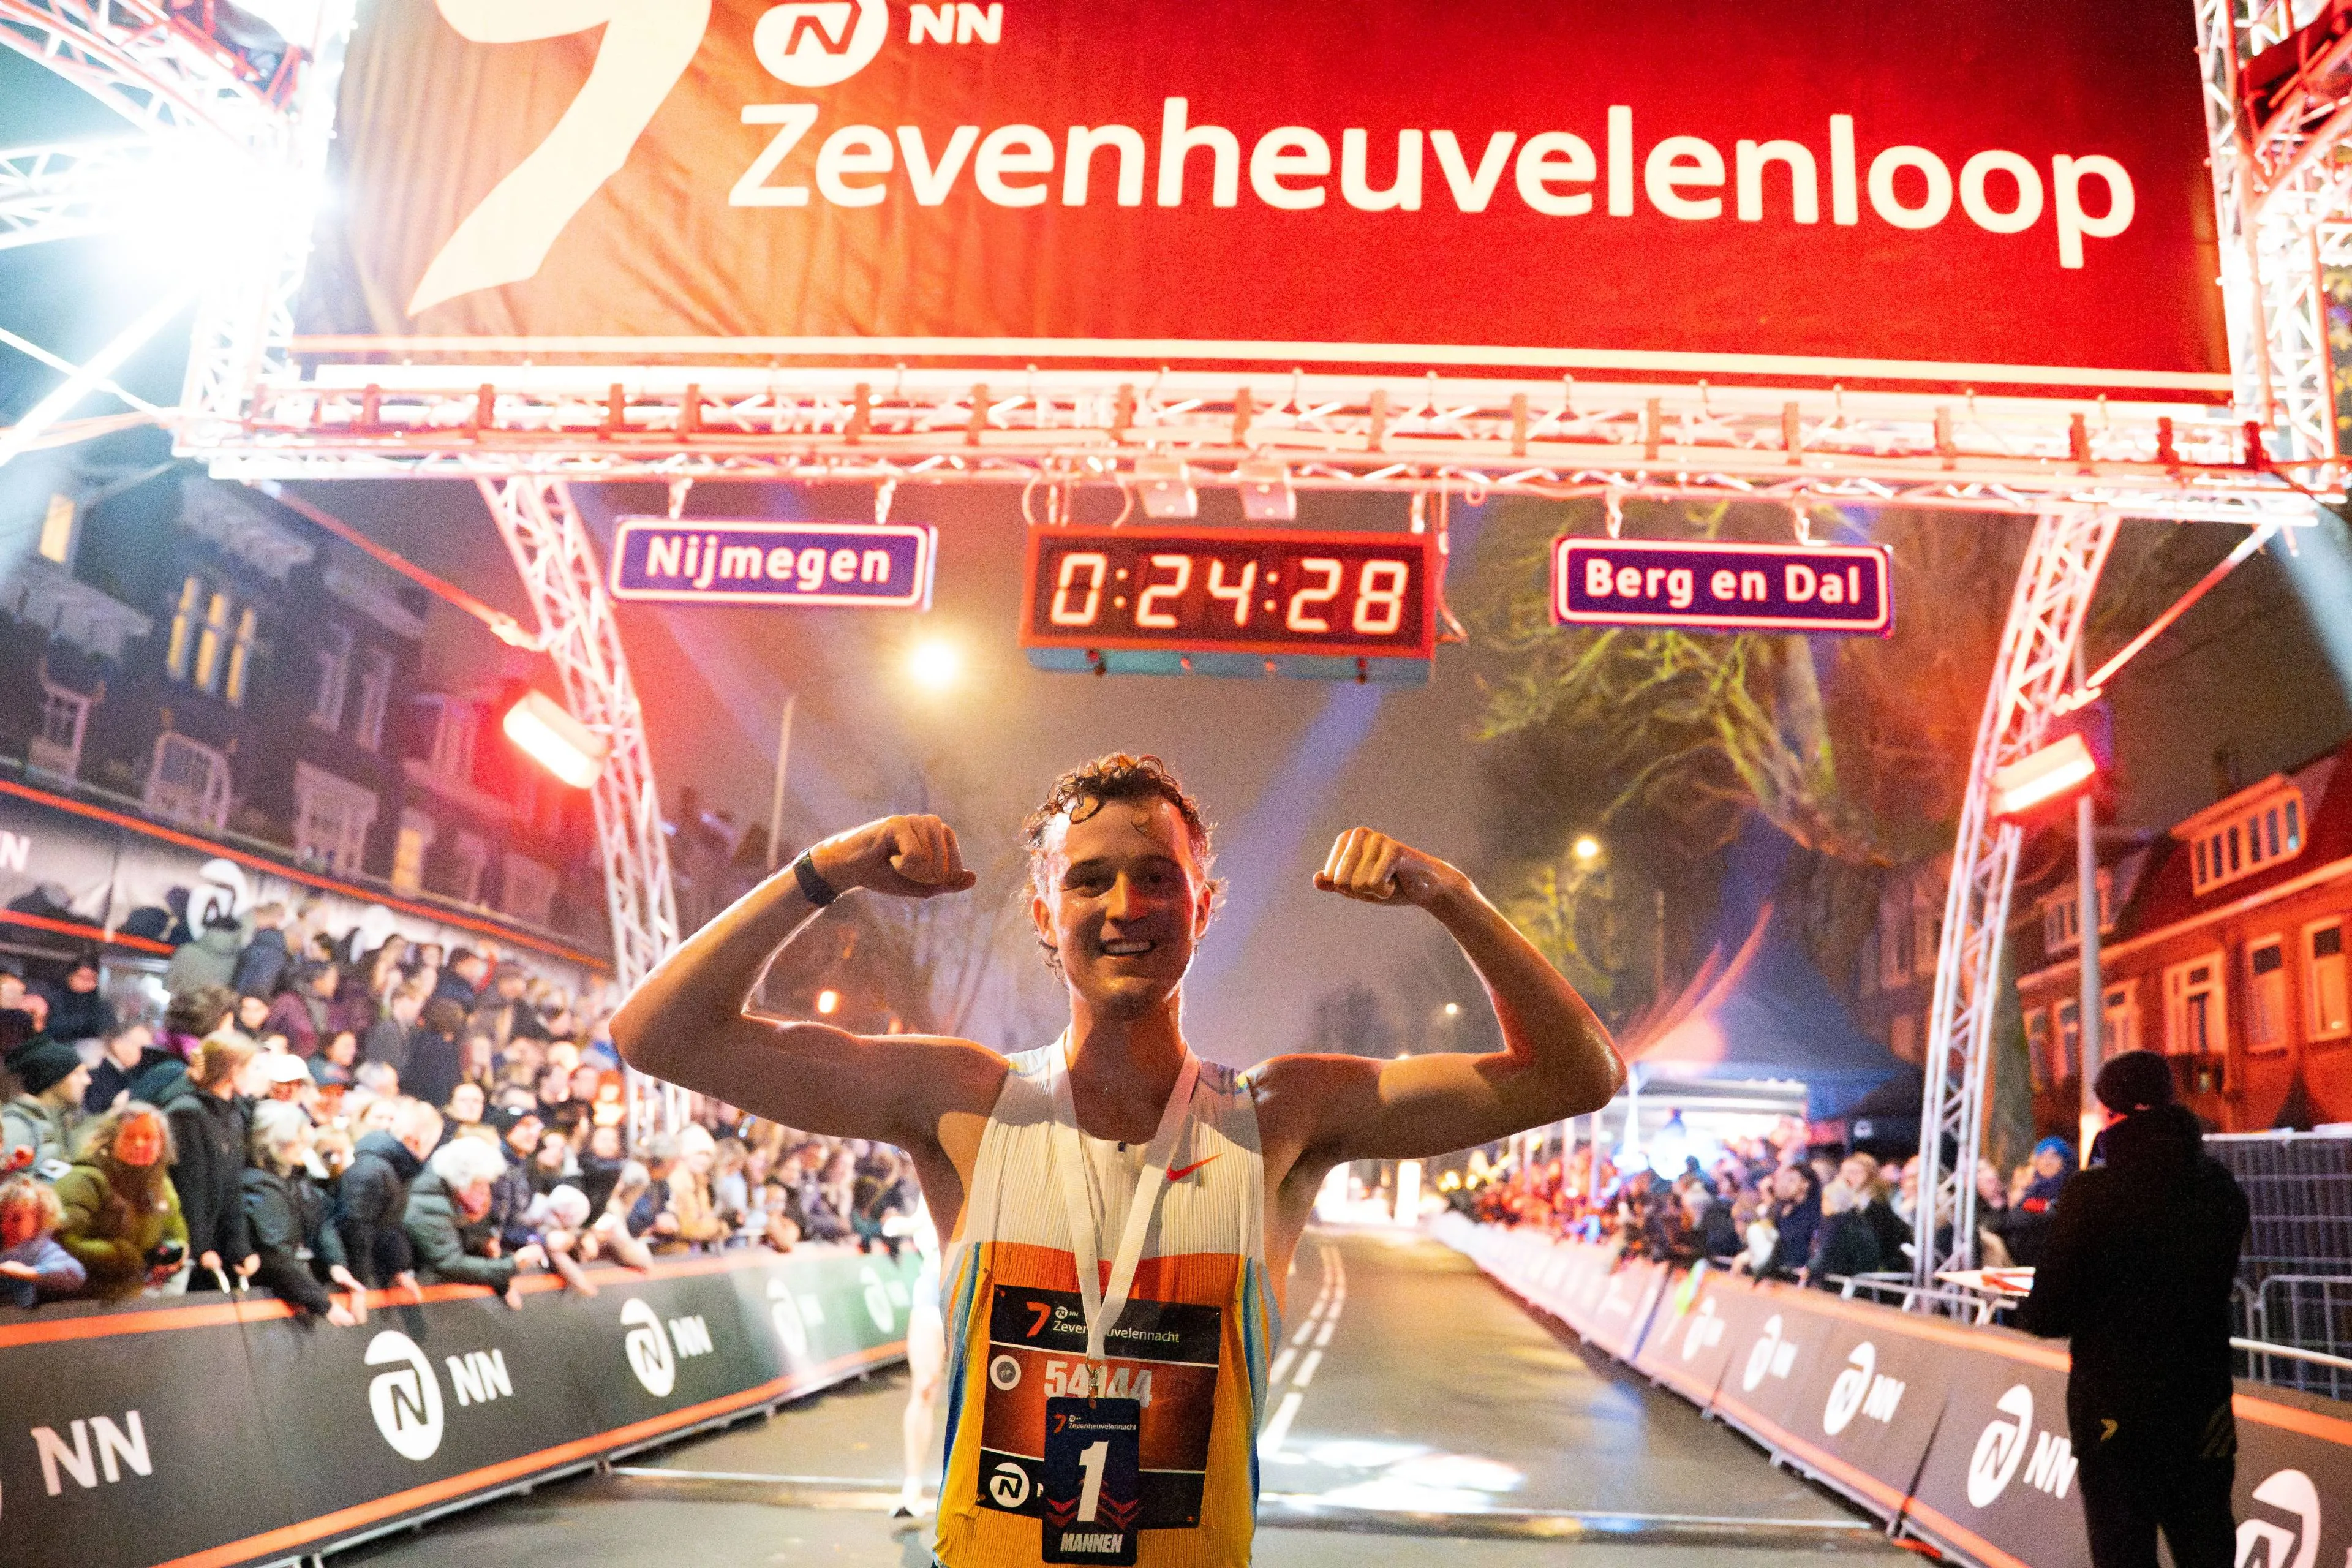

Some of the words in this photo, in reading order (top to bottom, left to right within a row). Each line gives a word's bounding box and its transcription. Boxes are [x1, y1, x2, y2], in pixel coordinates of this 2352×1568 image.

[908, 4, 1003, 45] NN
[728, 96, 2136, 271] Zevenheuvelenloop
[646, 534, 891, 592] Nijmegen
[1050, 552, 1409, 635] 0:24:28
[1585, 558, 1694, 609] Berg
[1711, 570, 1768, 601] en
[1785, 564, 1861, 604] Dal
[445, 1348, 514, 1407] NN
[31, 1410, 153, 1498] NN
[1077, 1441, 1109, 1522] 1
[2023, 1430, 2079, 1499] NN
[1060, 1533, 1123, 1553] MANNEN
